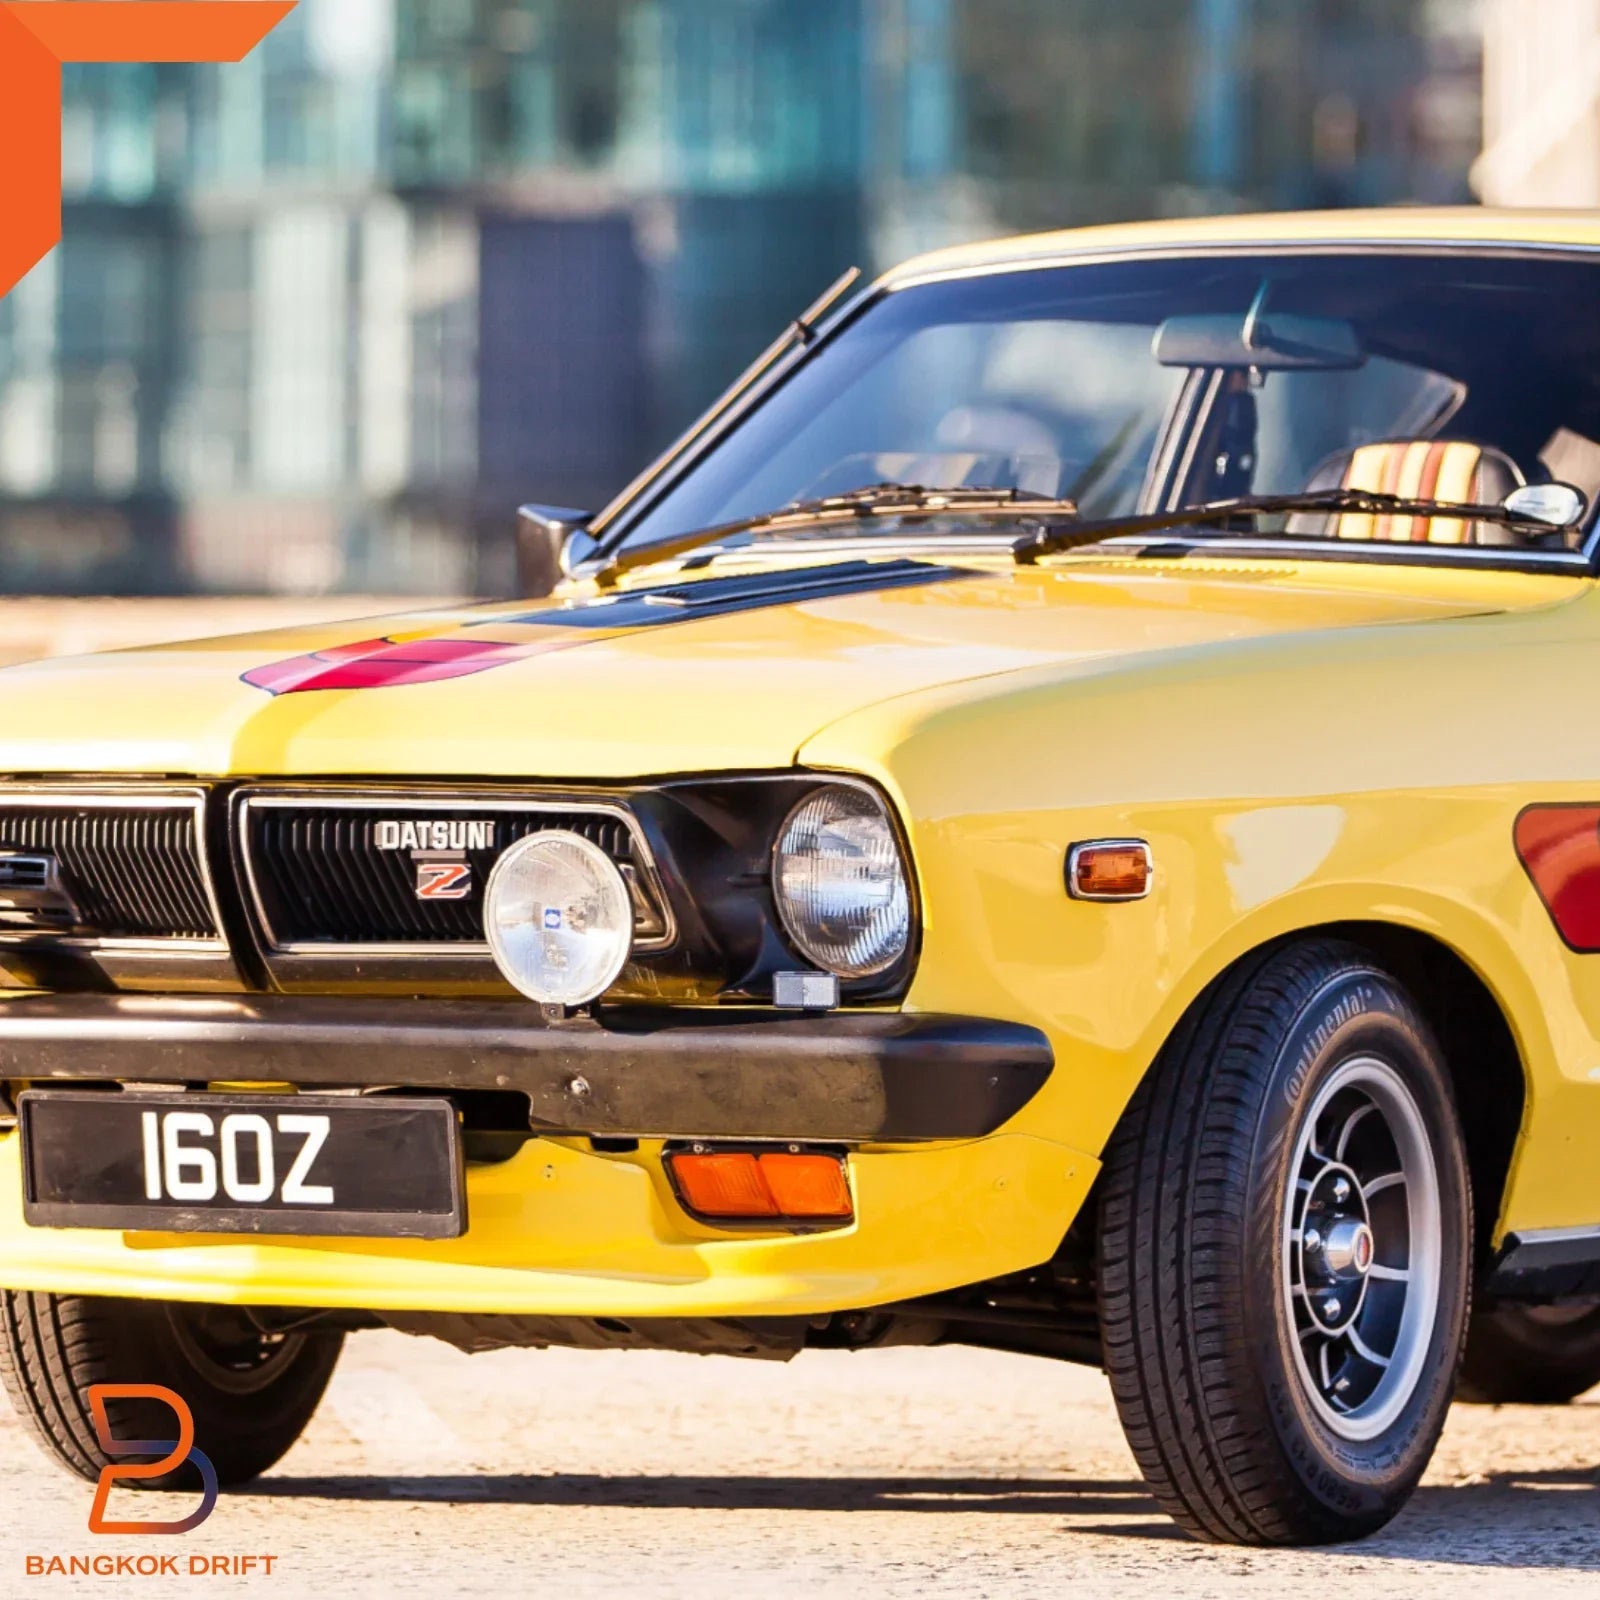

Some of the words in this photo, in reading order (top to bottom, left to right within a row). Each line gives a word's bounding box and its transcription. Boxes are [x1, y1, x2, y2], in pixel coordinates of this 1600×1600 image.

[376, 820, 494, 850] DATSUN
[416, 863, 471, 899] Z
[1284, 986, 1368, 1107] Continental
[141, 1111, 335, 1204] 160Z
